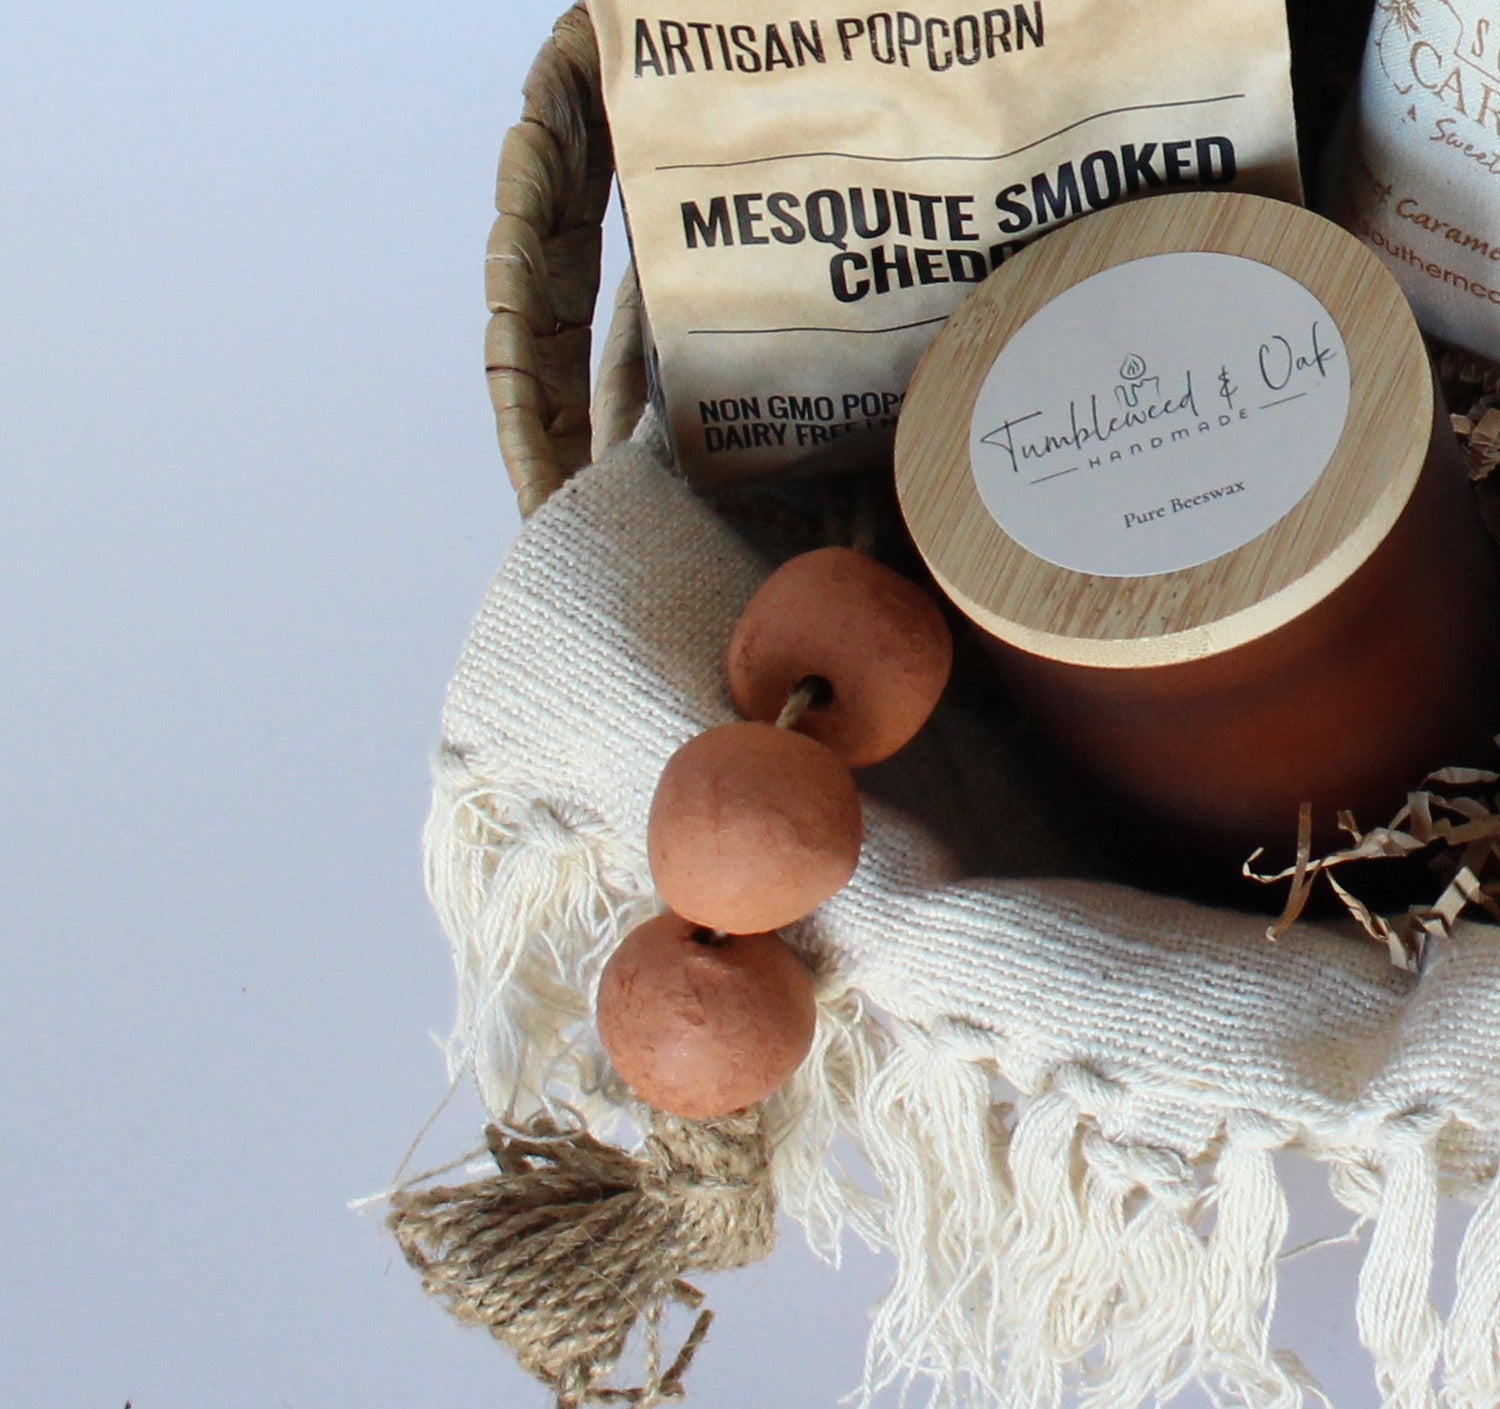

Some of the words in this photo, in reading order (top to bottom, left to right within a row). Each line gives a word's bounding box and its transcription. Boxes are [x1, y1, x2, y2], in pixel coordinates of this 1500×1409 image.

[633, 17, 827, 79] ARTISAN
[837, 0, 1046, 73] POPCORN
[680, 186, 980, 250] MESQUITE
[996, 135, 1238, 236] SMOKED
[698, 395, 762, 424] NON
[767, 394, 835, 422] GMO
[980, 370, 1200, 473] Tumbleweed
[1217, 365, 1239, 410] &
[1258, 321, 1337, 391] Oak
[703, 422, 788, 453] DAIRY
[1123, 503, 1167, 530] Pure
[1170, 480, 1247, 514] Beeswax
